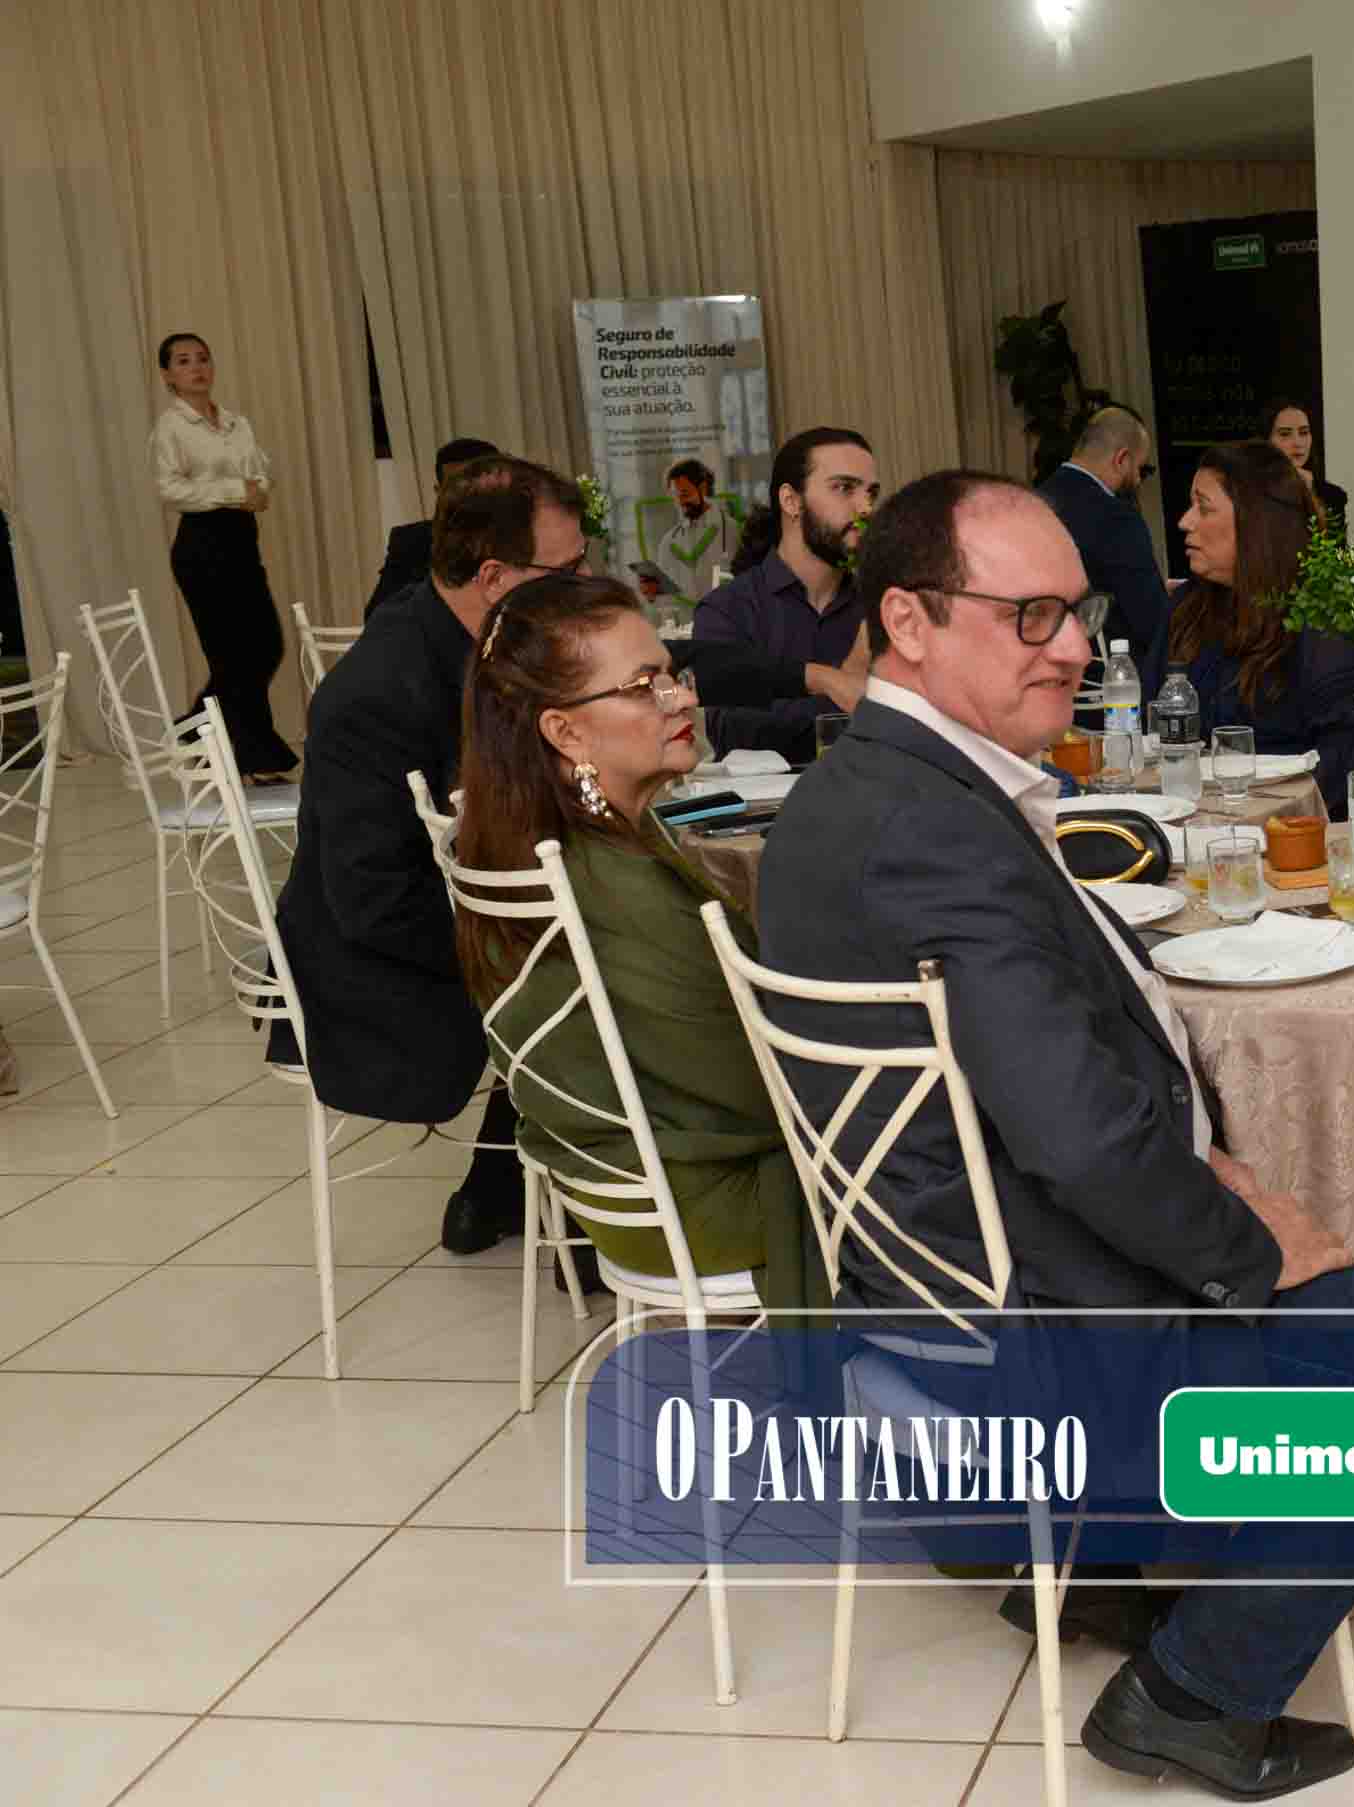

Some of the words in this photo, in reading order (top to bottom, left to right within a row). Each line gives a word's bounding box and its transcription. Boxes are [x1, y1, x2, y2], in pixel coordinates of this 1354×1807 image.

[596, 328, 652, 345] Seguro
[655, 326, 674, 341] de
[598, 343, 736, 362] Responsabilidade
[600, 365, 638, 380] Civil:
[641, 363, 706, 380] proteção
[602, 383, 671, 398] essencial
[604, 405, 632, 417] sua
